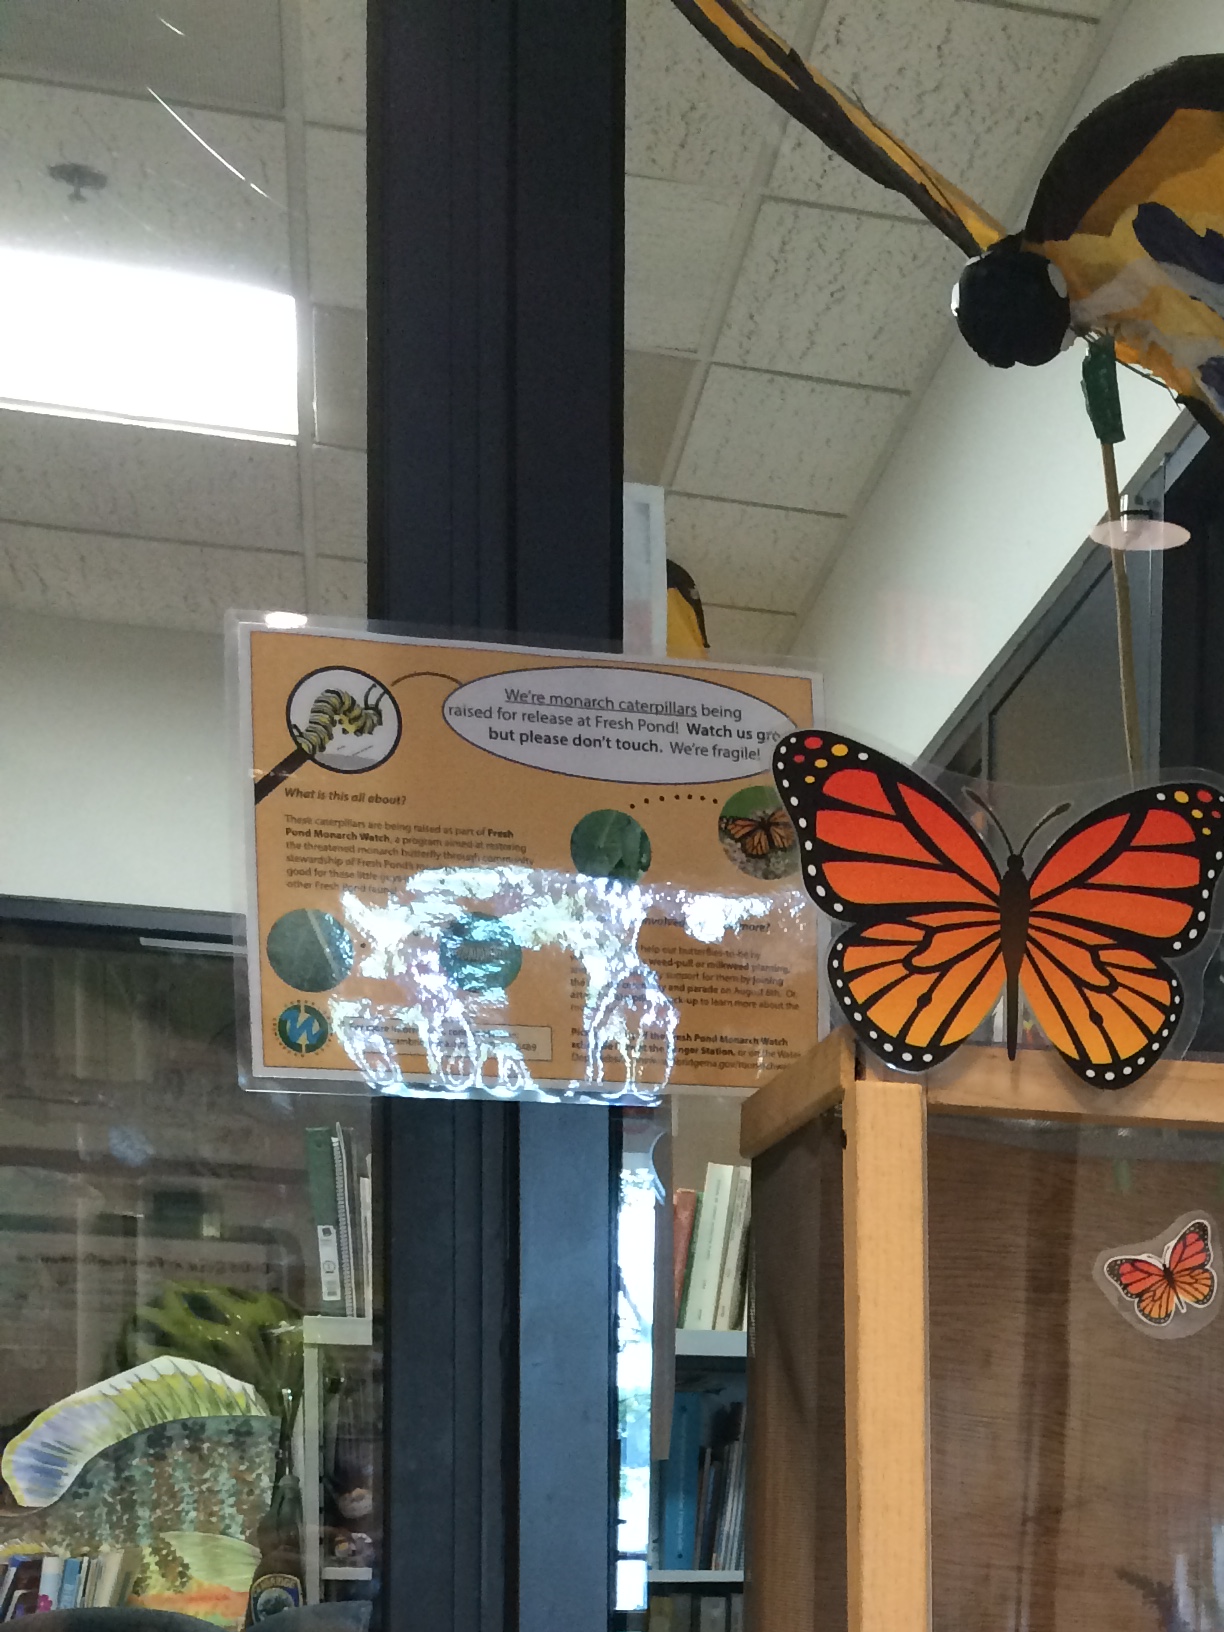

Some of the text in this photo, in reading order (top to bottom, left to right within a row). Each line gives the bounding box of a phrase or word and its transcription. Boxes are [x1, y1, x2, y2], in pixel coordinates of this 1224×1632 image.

[445, 702, 752, 739] raised for release at Fresh Pond! Watch us
[504, 688, 742, 722] We're monarch caterpillars being
[488, 726, 759, 762] but please don't touch. We're fragile!
